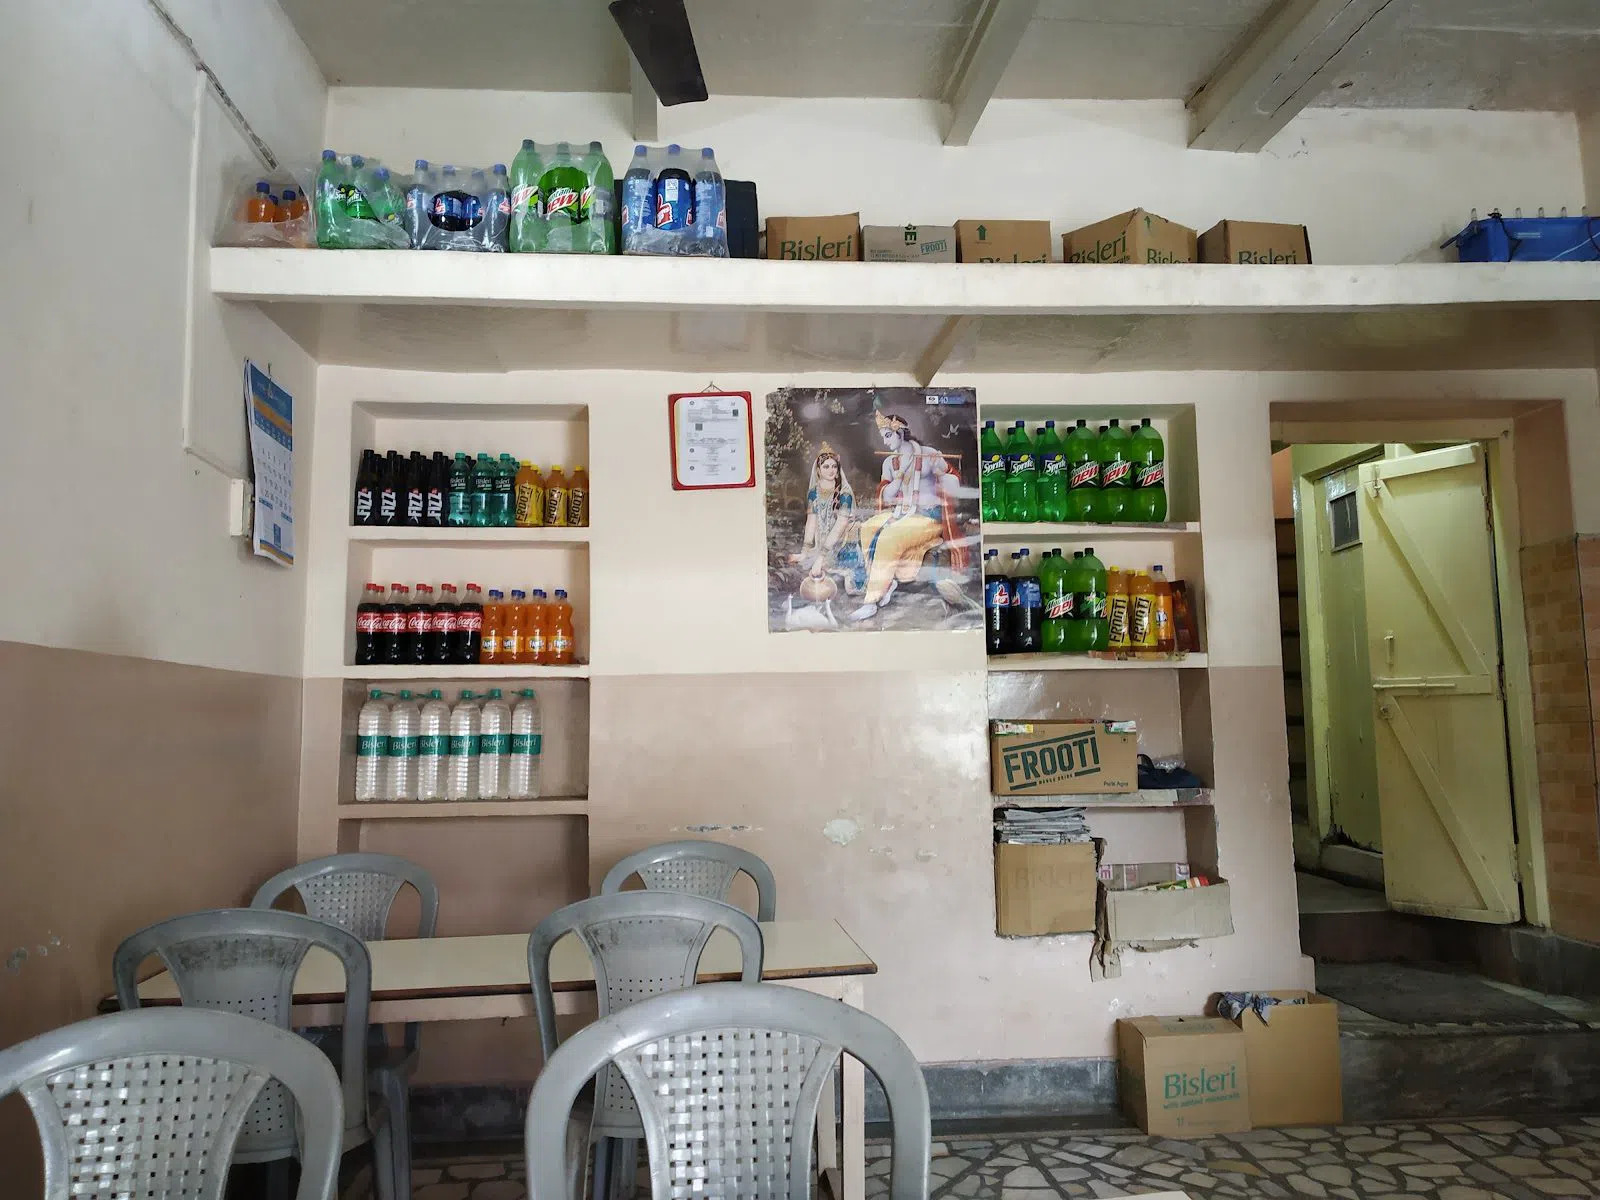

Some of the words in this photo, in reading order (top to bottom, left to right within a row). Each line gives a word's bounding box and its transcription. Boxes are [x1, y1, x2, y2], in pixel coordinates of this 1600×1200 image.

[780, 235, 853, 260] Bisleri
[921, 241, 947, 253] FROOTI
[1147, 248, 1191, 263] Bisl
[982, 459, 1004, 475] Sprite
[1011, 459, 1033, 475] Sprite
[357, 491, 372, 516] FIZZ
[381, 492, 396, 516] FIZZ
[408, 492, 422, 517] FIZZ
[427, 492, 442, 517] FIZZ
[362, 740, 385, 749] Bisleri
[393, 741, 417, 750] Bisleri
[1003, 737, 1100, 783] FROOTI
[1164, 1065, 1237, 1100] Bisleri
